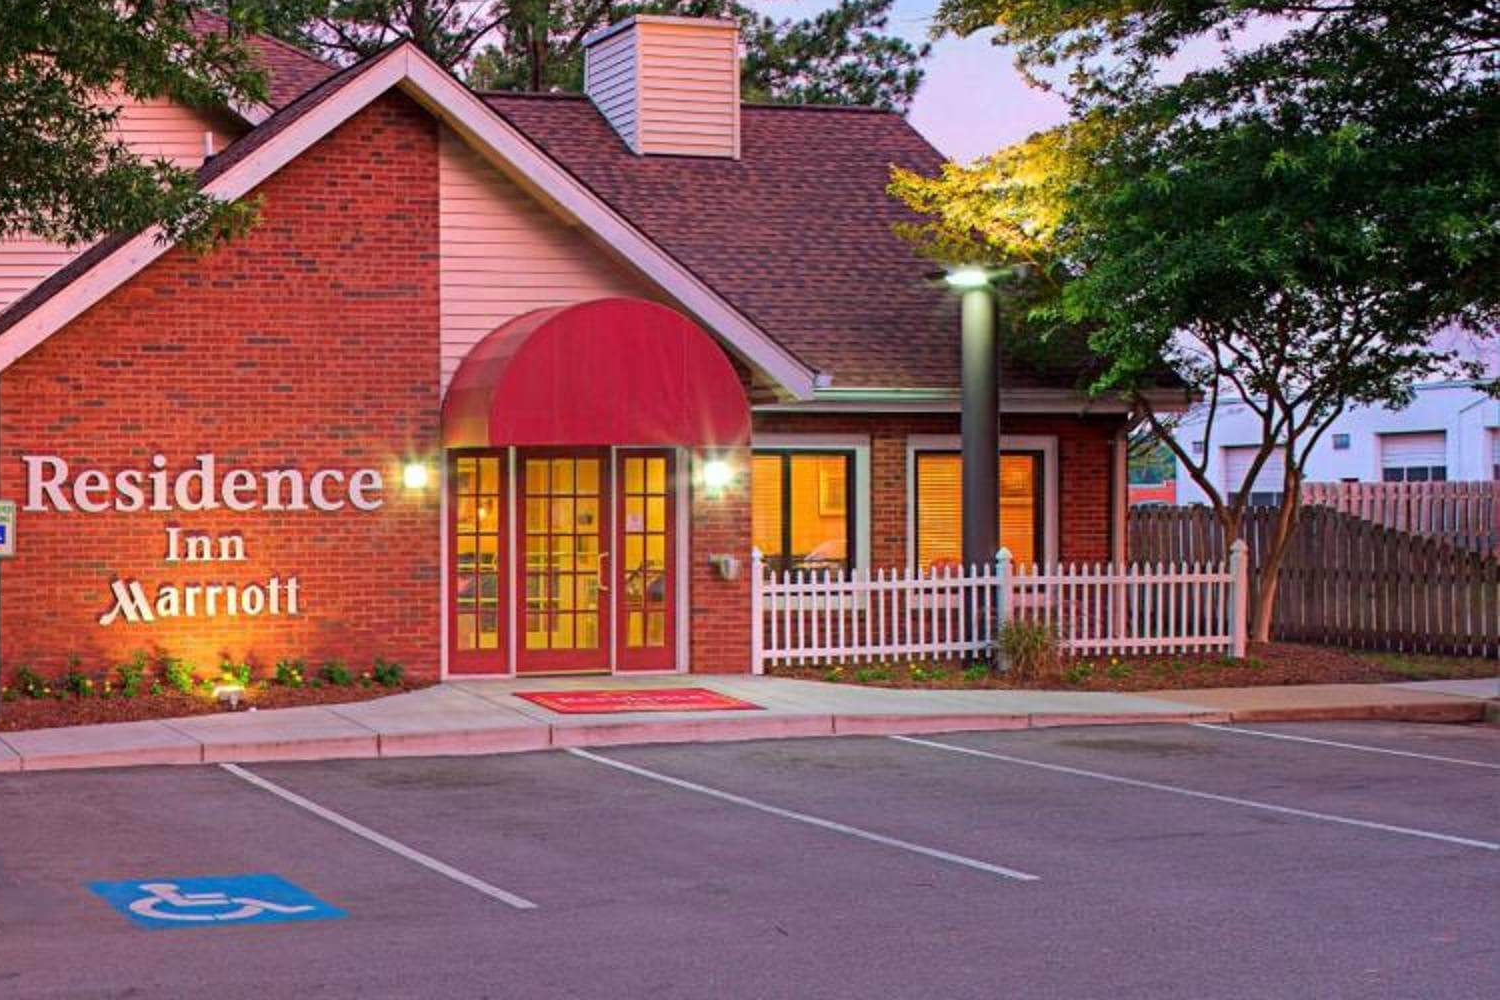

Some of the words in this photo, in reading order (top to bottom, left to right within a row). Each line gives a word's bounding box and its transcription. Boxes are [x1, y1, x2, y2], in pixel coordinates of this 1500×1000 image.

[22, 453, 384, 513] Residence
[165, 526, 248, 562] Inn
[100, 576, 301, 626] Marriott
